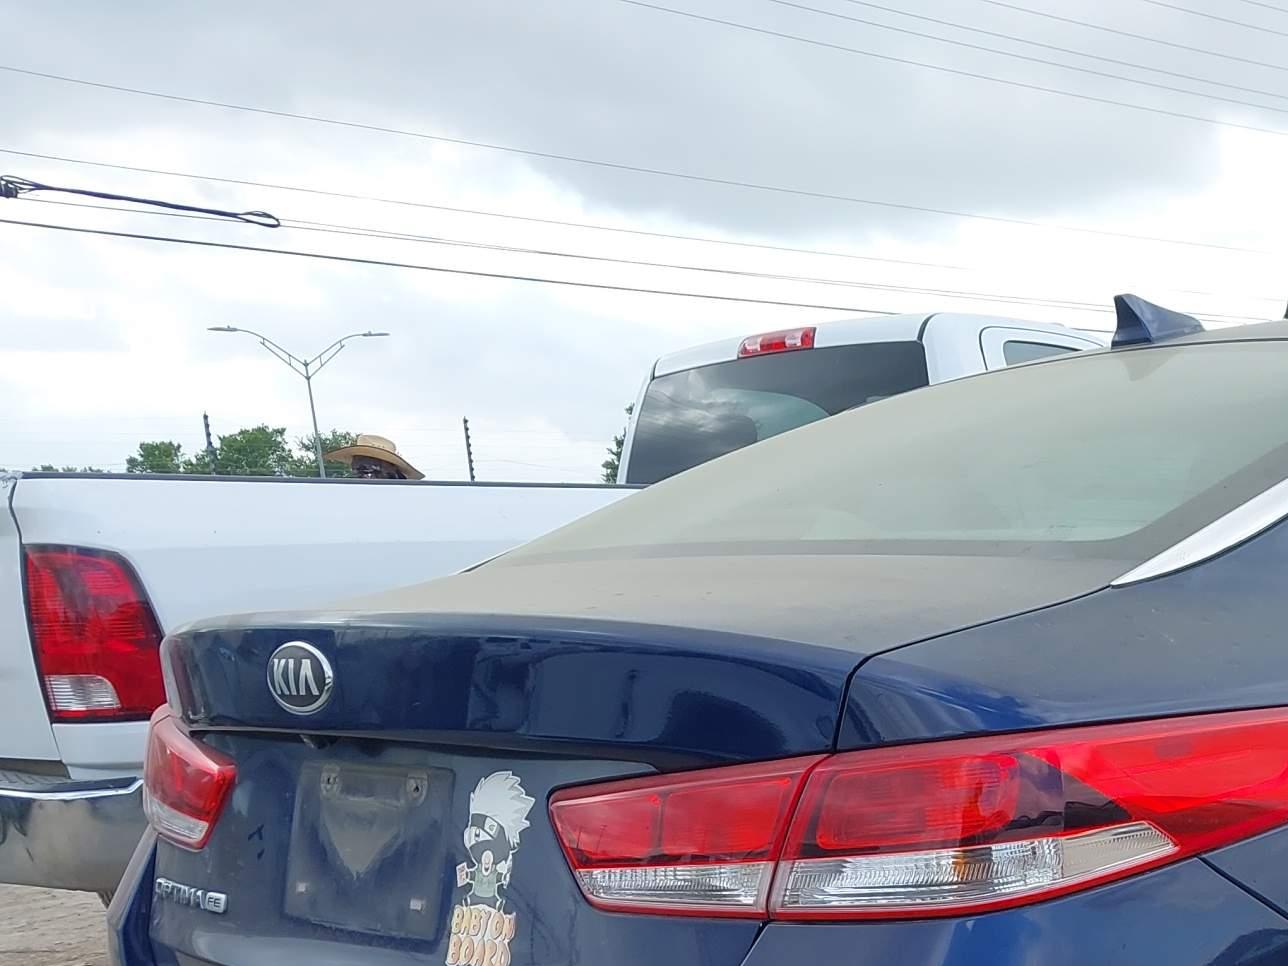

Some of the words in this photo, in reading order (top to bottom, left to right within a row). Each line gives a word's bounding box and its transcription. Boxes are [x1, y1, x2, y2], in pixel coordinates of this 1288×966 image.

[273, 658, 320, 695] KIA
[451, 907, 492, 938] BABY
[489, 911, 515, 940] ON
